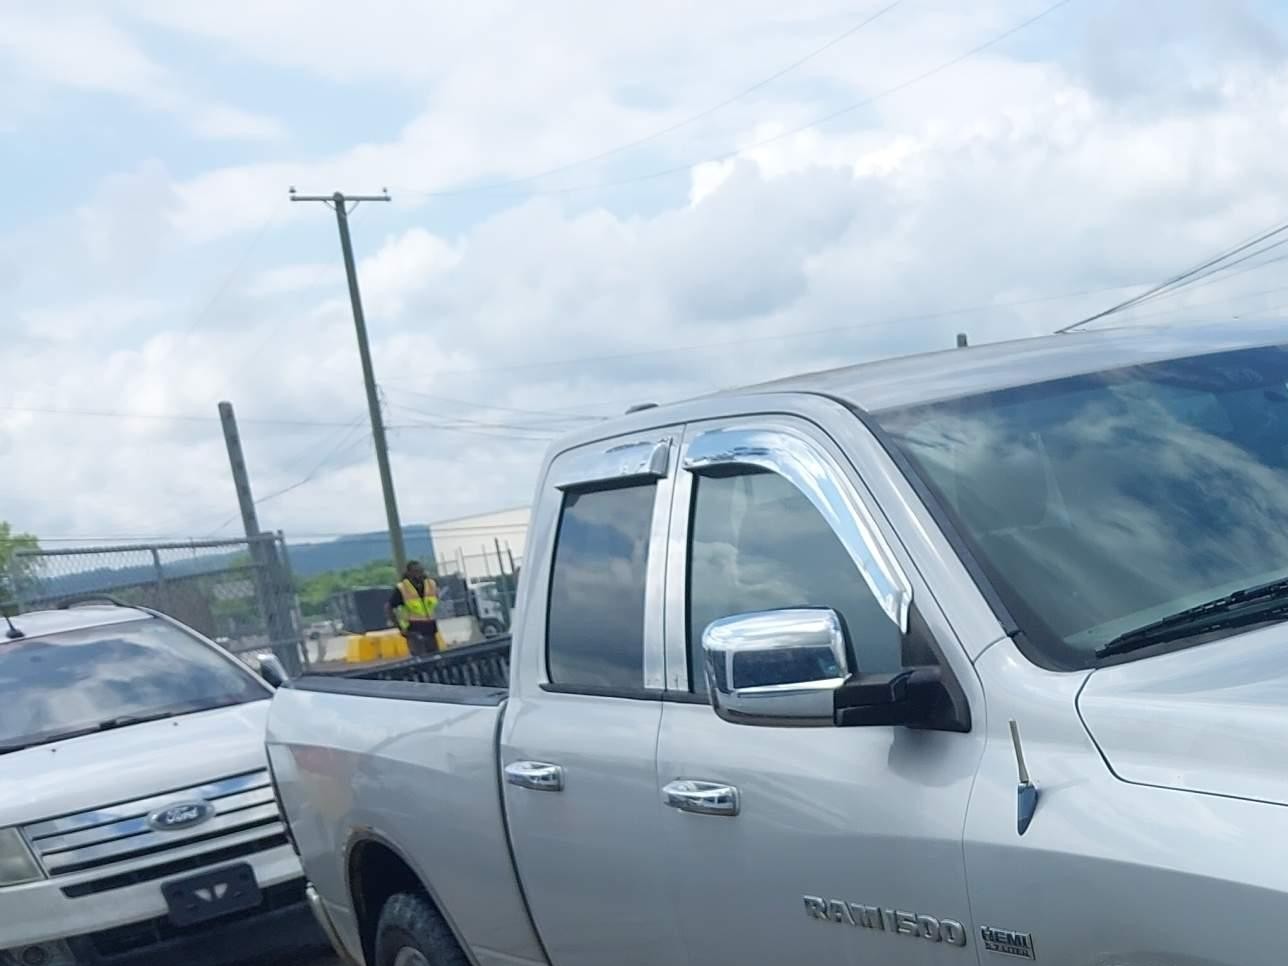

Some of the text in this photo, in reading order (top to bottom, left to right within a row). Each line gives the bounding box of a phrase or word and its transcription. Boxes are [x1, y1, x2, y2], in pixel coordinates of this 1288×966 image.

[167, 806, 198, 824] Ford
[803, 895, 967, 947] RAM 1500
[981, 927, 1029, 948] HEMI
